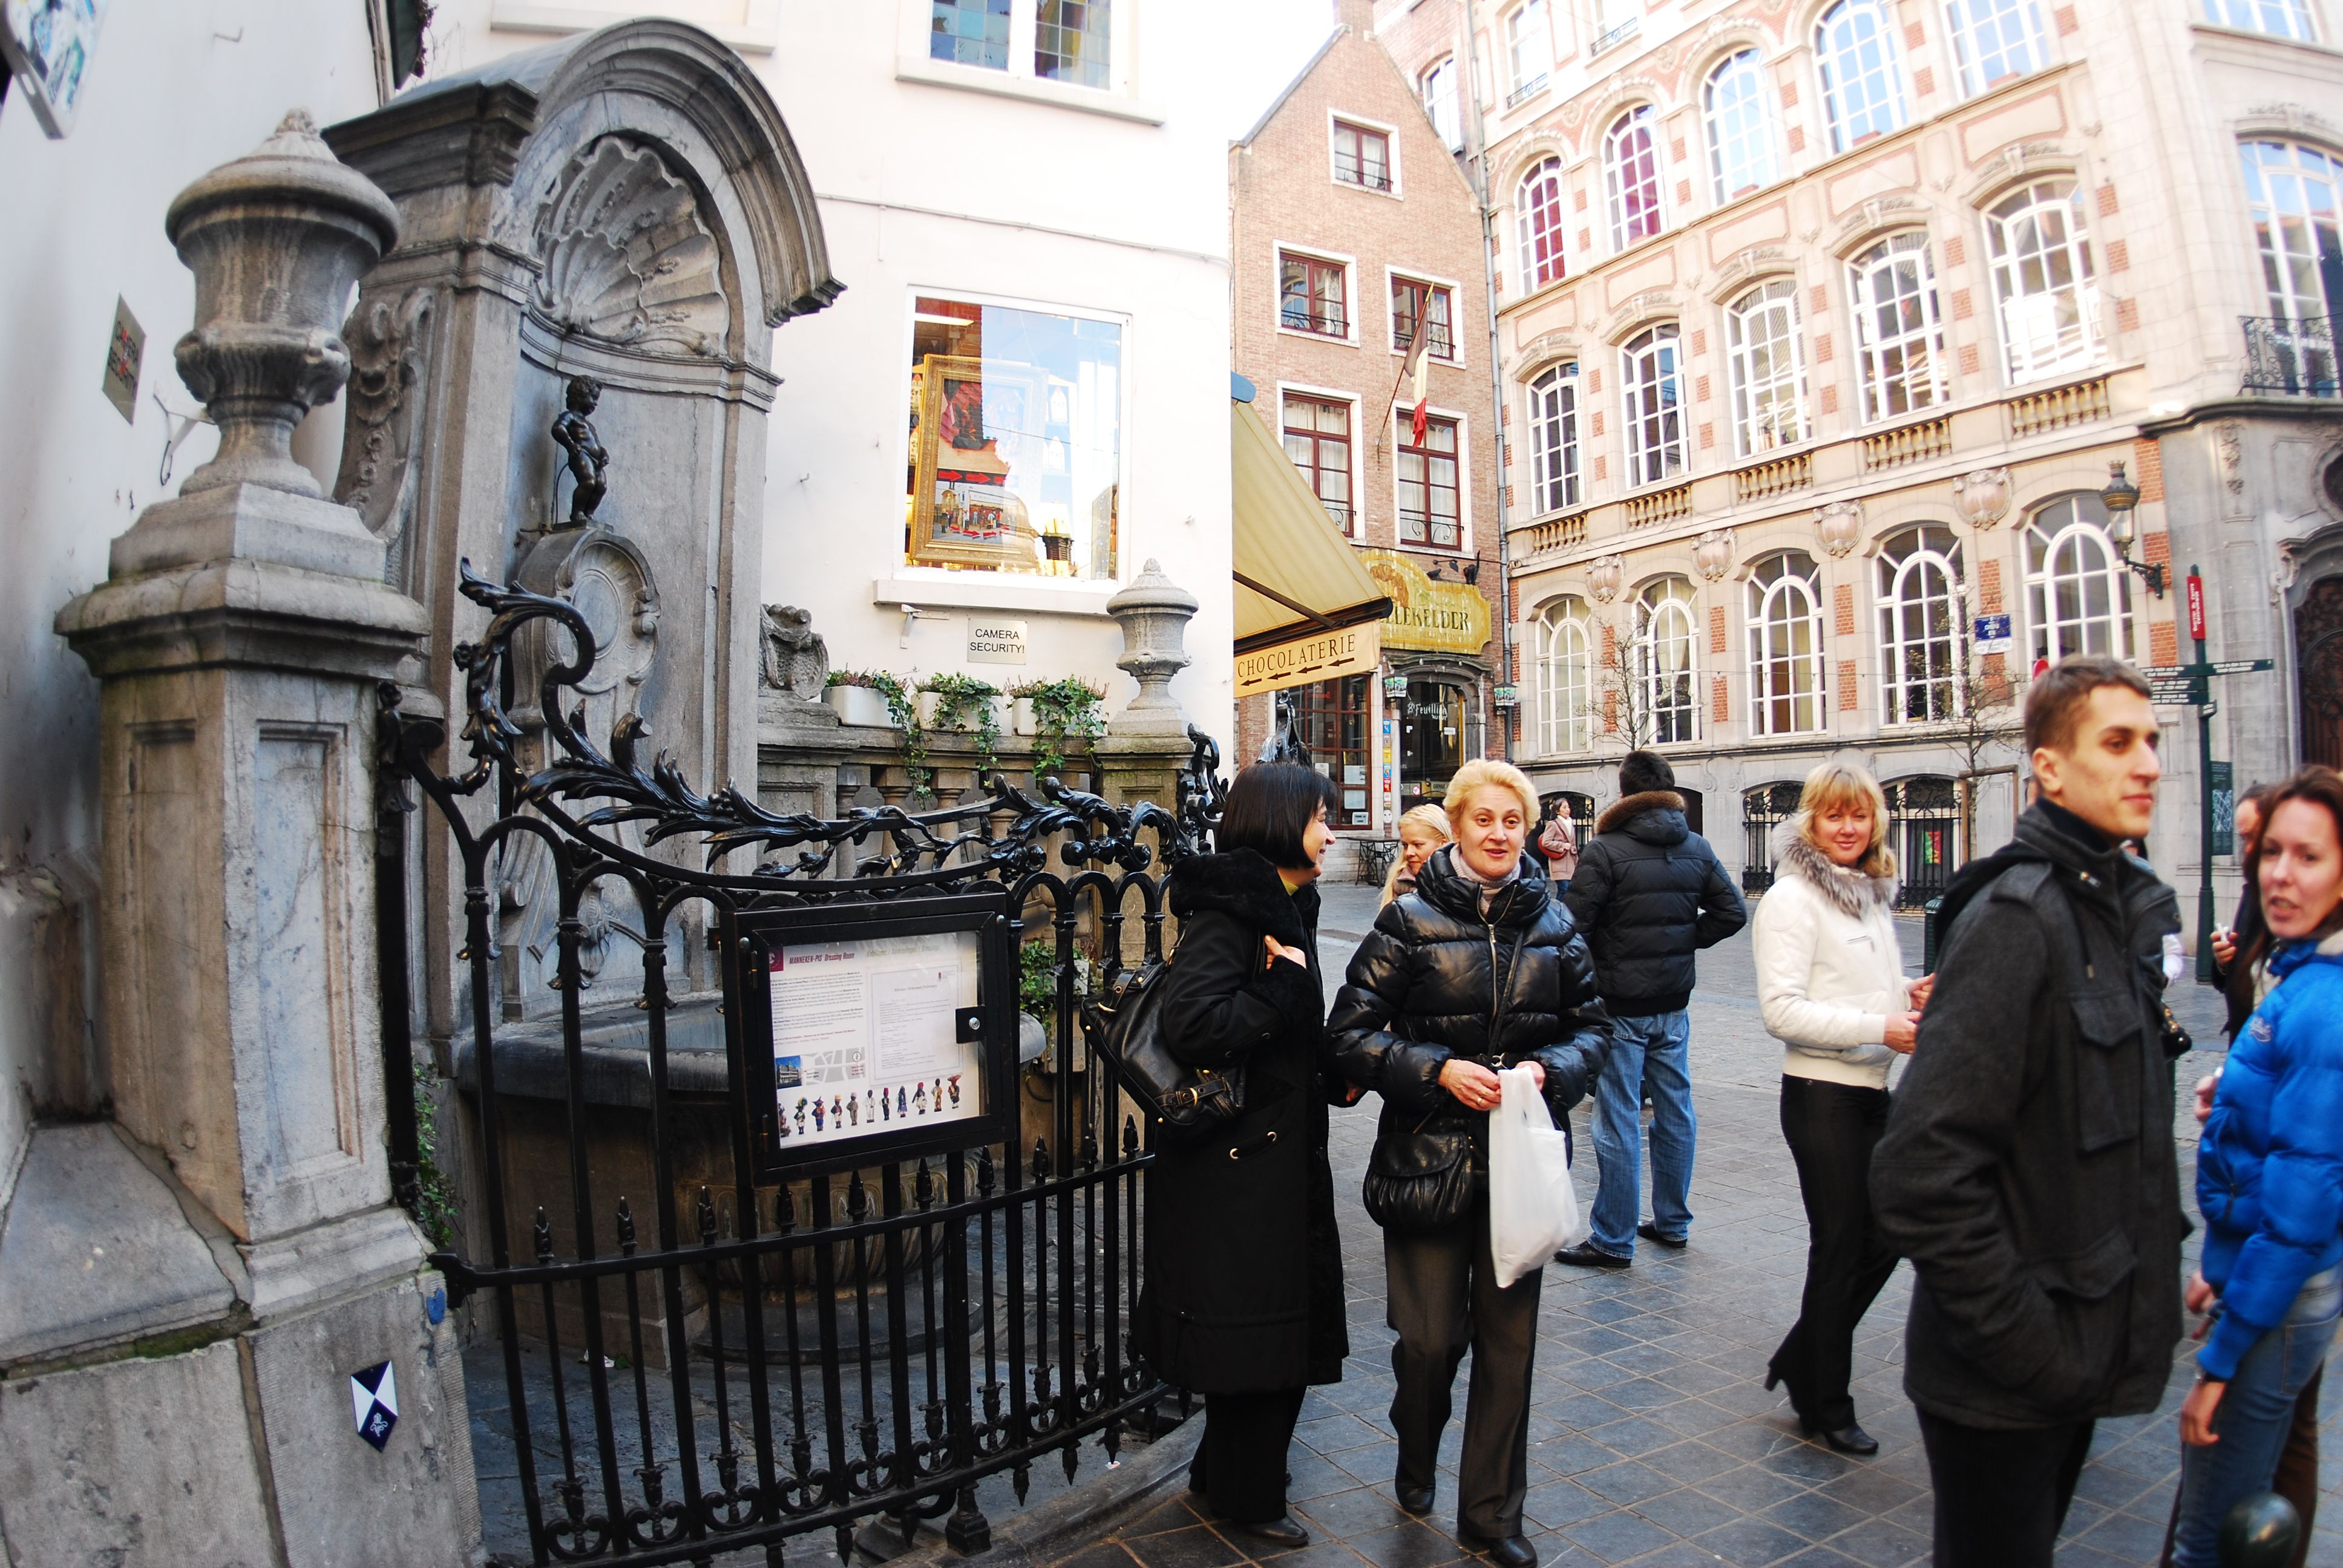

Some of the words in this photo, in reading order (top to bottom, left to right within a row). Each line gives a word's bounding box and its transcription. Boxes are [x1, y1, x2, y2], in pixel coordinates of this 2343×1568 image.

[975, 629, 1020, 639] CAMERA
[970, 642, 1024, 653] SECURITY!
[1237, 633, 1355, 678] CHOCOLATERIE
[789, 953, 823, 964] MANNEKEN-PIS
[824, 952, 842, 962] Dressing
